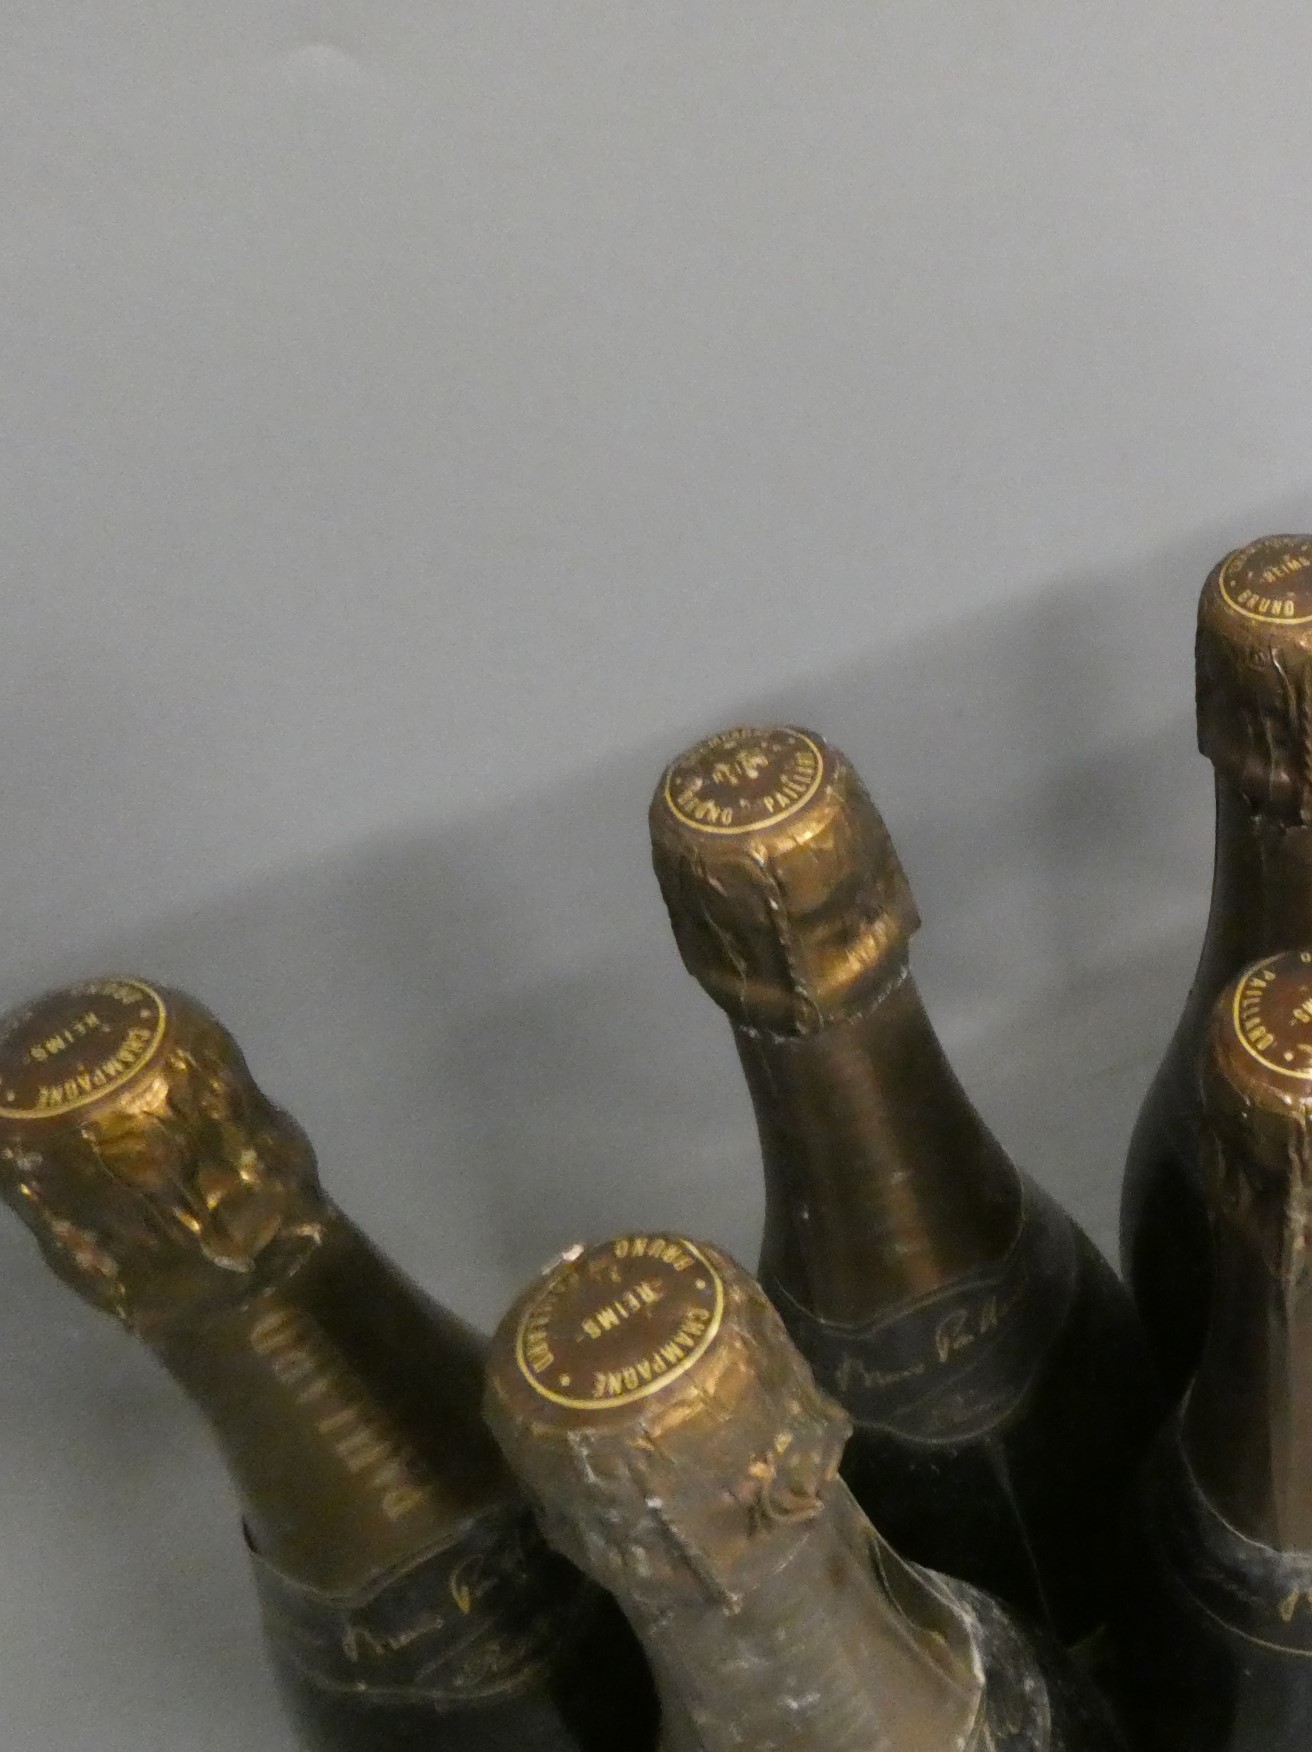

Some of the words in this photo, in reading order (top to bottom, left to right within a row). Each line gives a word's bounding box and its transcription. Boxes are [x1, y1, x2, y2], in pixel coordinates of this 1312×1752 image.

[1238, 588, 1295, 617] BRUNO
[1242, 969, 1276, 1051] PAILLARD
[614, 1237, 696, 1272] BRUNO
[581, 1280, 661, 1340] REIMS
[593, 1306, 711, 1399] CHAMPAGNE
